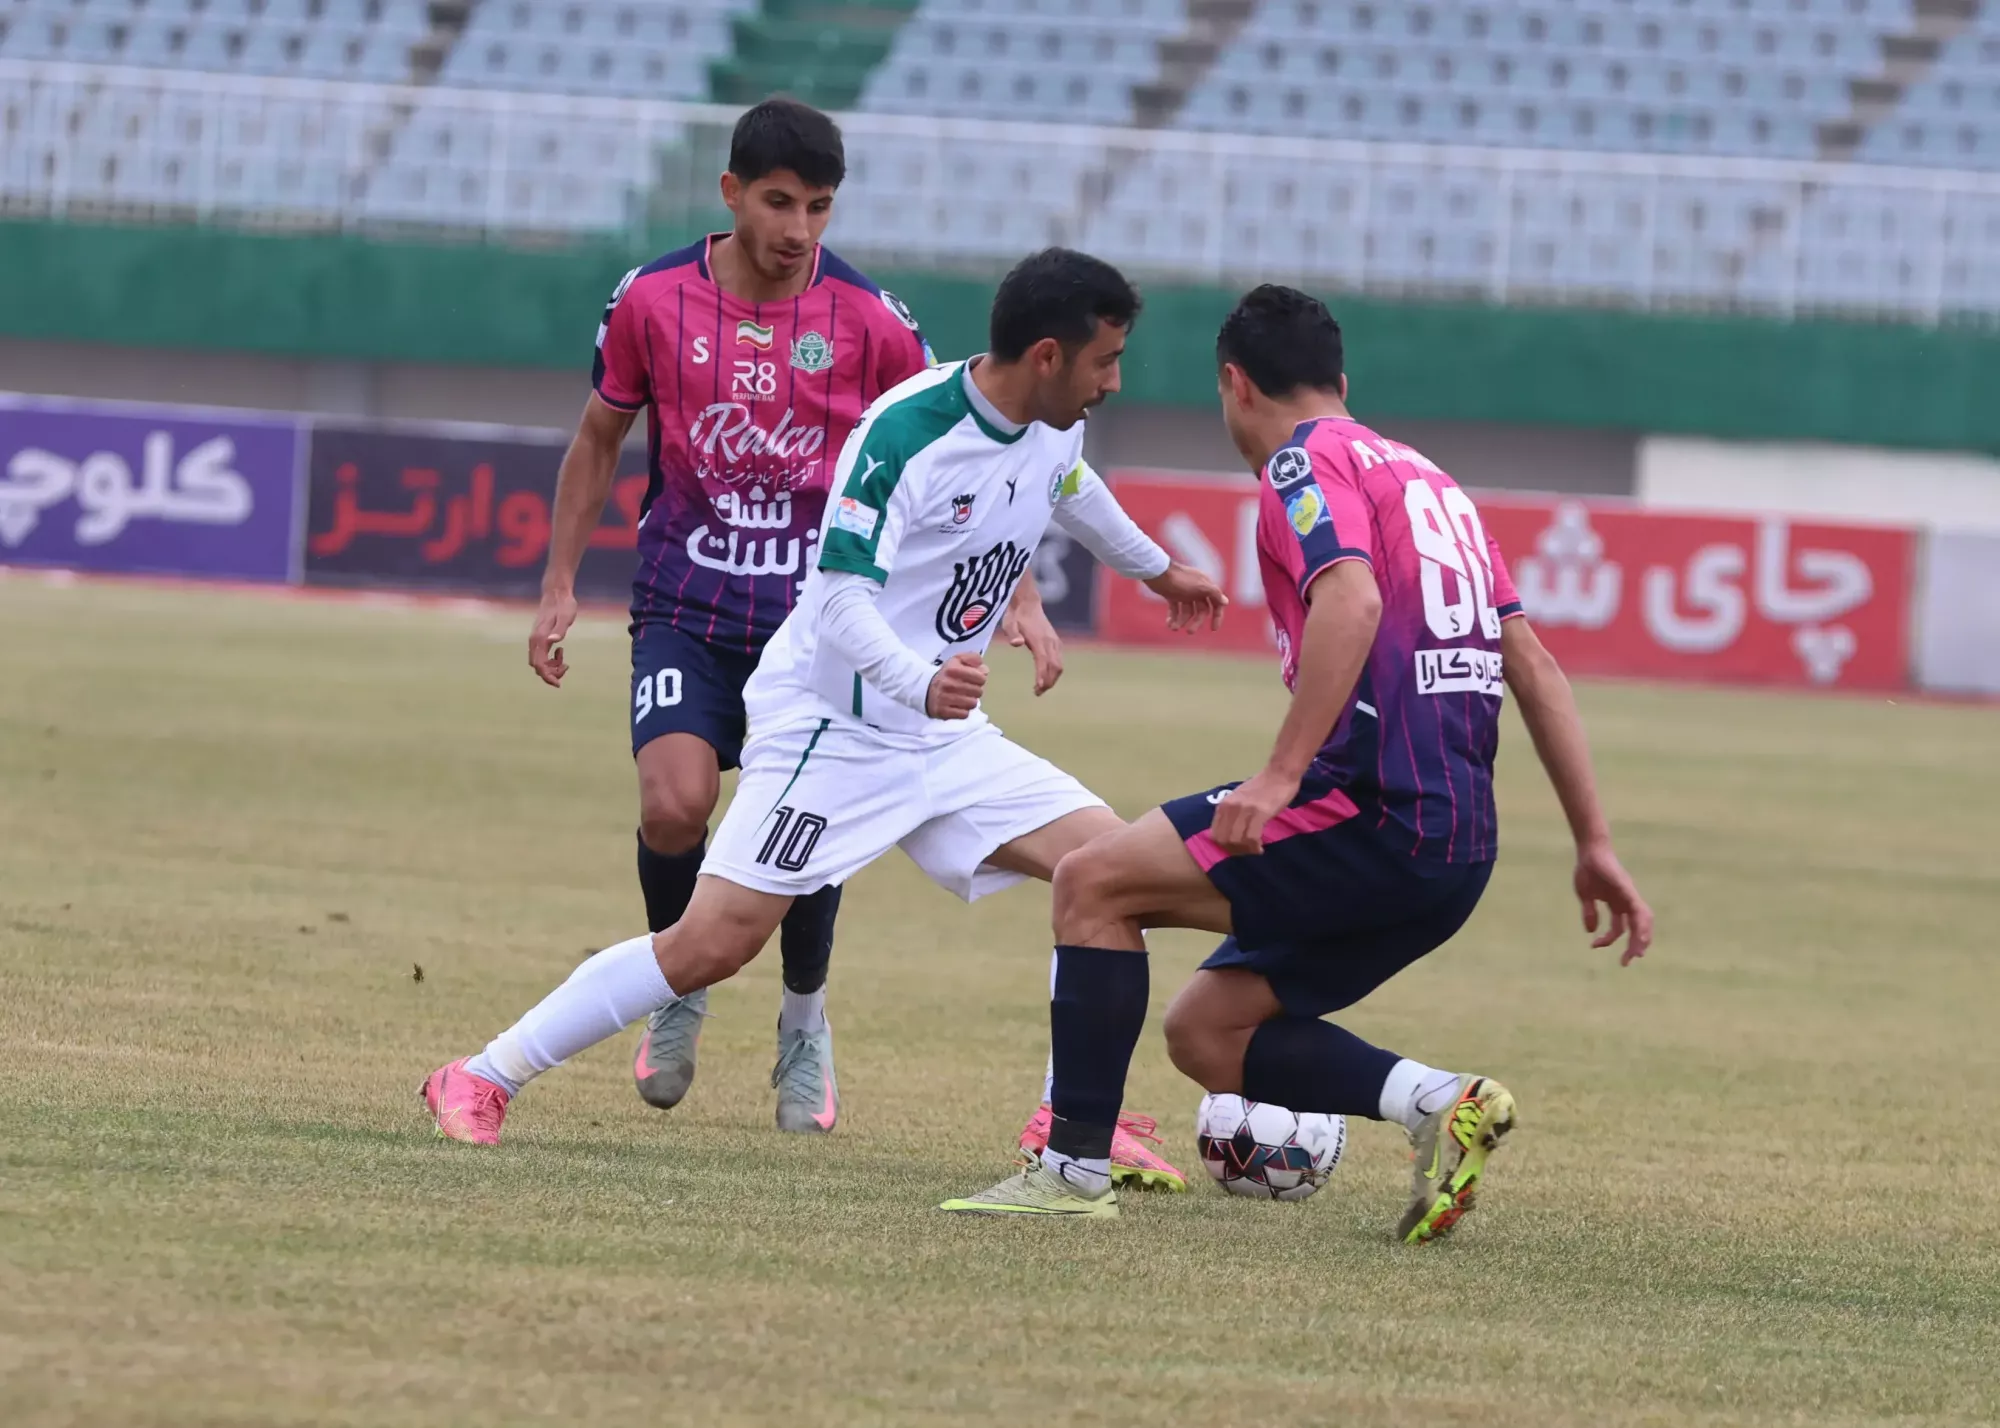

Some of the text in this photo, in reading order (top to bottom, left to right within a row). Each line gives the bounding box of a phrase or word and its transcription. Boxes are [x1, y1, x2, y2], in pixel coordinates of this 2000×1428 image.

[732, 360, 777, 395] R8
[732, 392, 775, 402] PERFUME BAR
[690, 403, 826, 464] iRalco
[0, 429, 254, 547] کلوچ
[1643, 510, 1874, 686] چای
[635, 667, 683, 725] 90
[1420, 651, 1472, 690] کارا
[755, 806, 828, 872] 10
